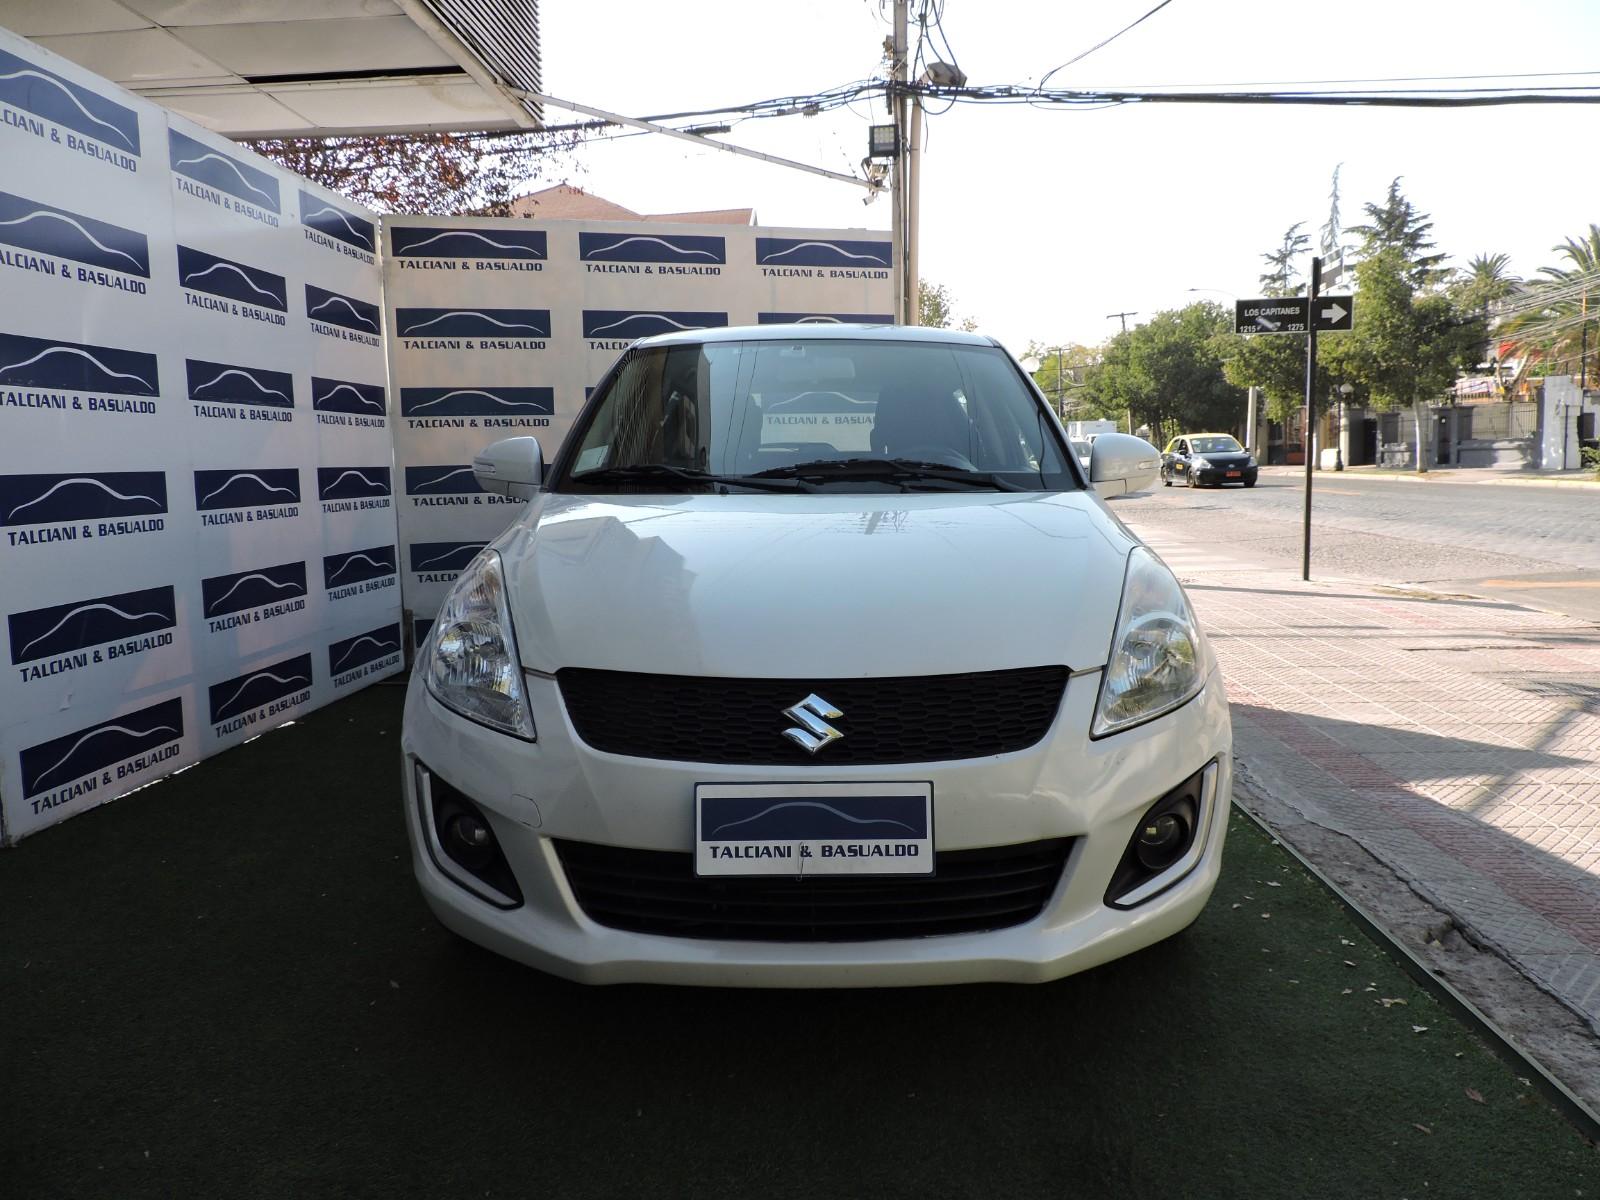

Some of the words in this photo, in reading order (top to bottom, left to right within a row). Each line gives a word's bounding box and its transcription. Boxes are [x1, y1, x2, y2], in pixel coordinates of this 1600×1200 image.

[50, 128, 61, 144] &
[67, 134, 137, 173] BASUALDO
[176, 177, 221, 206] TALCIANI
[224, 197, 231, 210] &
[234, 201, 279, 228] BASUALDO
[304, 229, 334, 249] TALCIANI
[336, 241, 341, 252] &
[343, 245, 374, 265] BASUALDO
[399, 260, 456, 270] TALCIANI
[461, 261, 471, 270] &
[476, 262, 542, 271] BASUALDO
[586, 264, 640, 274] TALCIANI
[645, 265, 654, 274] &
[658, 266, 721, 275] BASUALDO
[762, 268, 812, 277] TALCIANI
[817, 270, 825, 278] &
[830, 270, 888, 279] BASUALDO
[61, 264, 72, 279] &
[77, 267, 146, 295] BASUALDO
[185, 293, 229, 313] TALCIANI
[231, 304, 239, 316] &
[242, 306, 286, 326] BASUALDO
[1244, 308, 1259, 317] LOS
[1260, 307, 1300, 316] CAPITANES
[310, 322, 340, 338] TALCIANI
[341, 330, 347, 340] &
[349, 332, 379, 347] BASUALDO
[403, 340, 460, 349] TALCIANI
[466, 340, 475, 350] &
[480, 341, 546, 350] BASUALDO
[72, 396, 83, 410] &
[88, 397, 156, 414] BASUALDO
[193, 405, 236, 419] TALCIANI
[240, 409, 247, 420] &
[249, 409, 292, 422] BASUALDO
[317, 414, 346, 425] TALCIANI
[347, 417, 353, 426] &
[355, 417, 385, 428] BASUALDO
[408, 419, 464, 429] TALCIANI
[469, 418, 479, 428] &
[484, 418, 549, 427] BASUALDO
[767, 416, 817, 425] TALCIANI
[822, 415, 830, 424] &
[322, 502, 351, 514] TALCIANI
[353, 501, 358, 511] &
[360, 499, 390, 510] BASUALDO
[412, 496, 468, 506] TALCIANI
[473, 495, 483, 505] &
[201, 512, 243, 526] TALCIANI
[246, 511, 253, 522] &
[256, 507, 298, 520] BASUALDO
[7, 526, 77, 546] TALCIANI
[83, 525, 93, 538] &
[98, 519, 164, 537] BASUALDO
[328, 586, 357, 601] TALCIANI
[358, 585, 364, 596] &
[365, 576, 395, 594] BASUALDO
[209, 613, 251, 633] TALCIANI
[254, 610, 260, 622] &
[263, 599, 305, 619] BASUALDO
[20, 653, 88, 682] TALCIANI
[93, 649, 103, 663] &
[108, 632, 173, 660] BASUALDO
[334, 669, 362, 688] TALCIANI
[364, 667, 369, 679] &
[370, 654, 400, 676] BASUALDO
[215, 712, 256, 738] TALCIANI
[259, 707, 266, 720] &
[269, 690, 310, 716] BASUALDO
[31, 777, 97, 815] TALCIANI
[102, 772, 112, 786] &
[117, 744, 180, 779] BASUALDO
[709, 845, 791, 859] TALCIANI
[800, 845, 813, 858] &
[821, 844, 919, 857] BASUALDO
